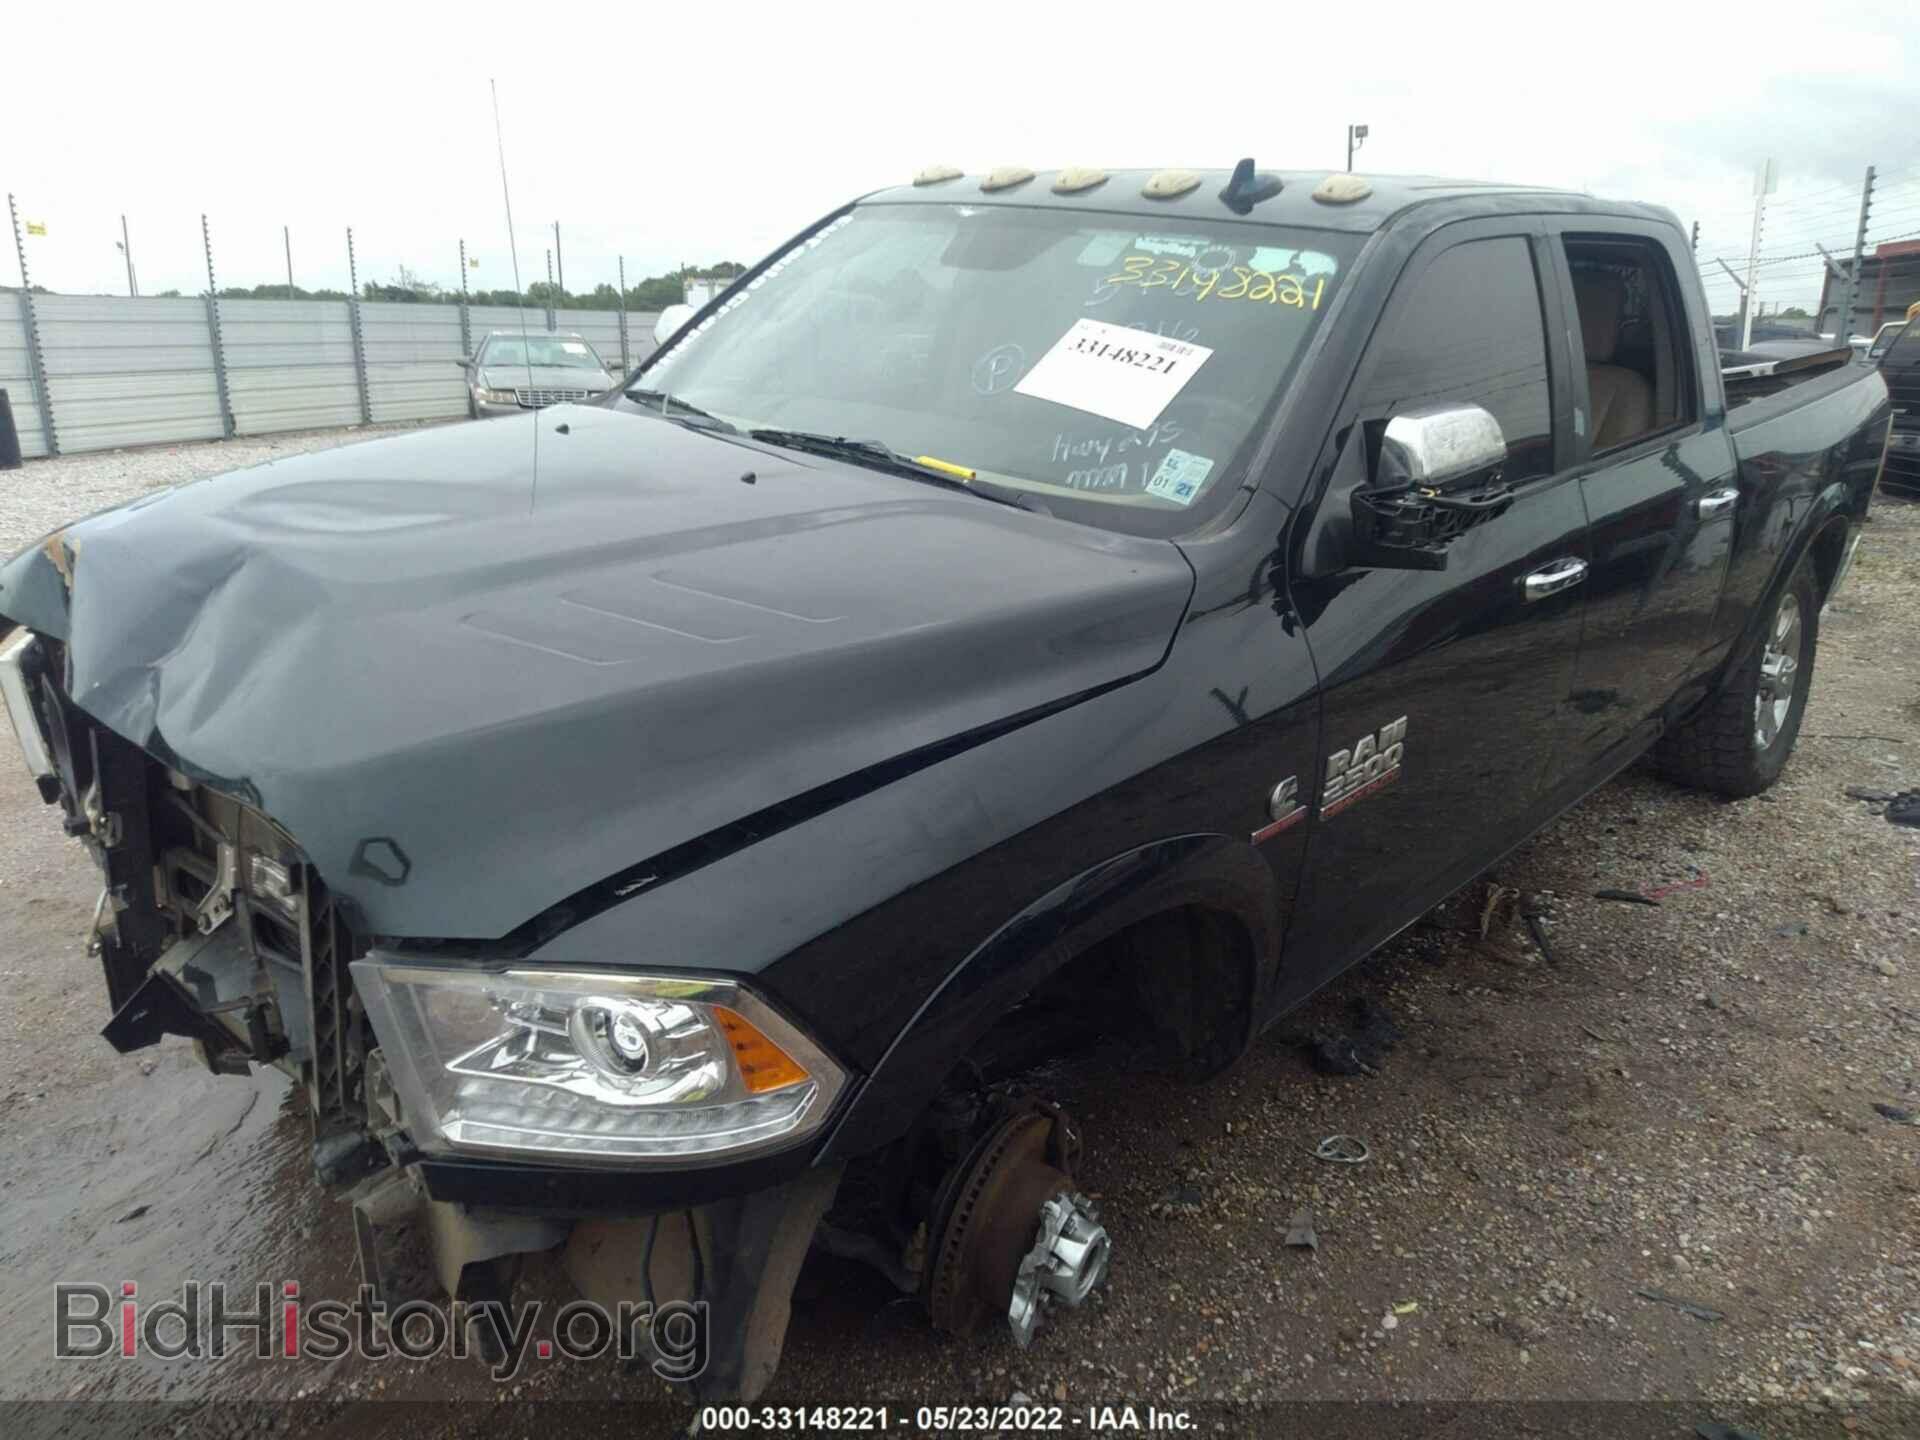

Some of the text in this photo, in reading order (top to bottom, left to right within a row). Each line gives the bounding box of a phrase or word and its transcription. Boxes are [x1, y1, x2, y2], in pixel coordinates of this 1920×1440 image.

[1107, 256, 1325, 310] 33148221
[1068, 337, 1177, 375] 33148221
[1153, 476, 1193, 496] 01 21
[1326, 715, 1408, 781] RAM
